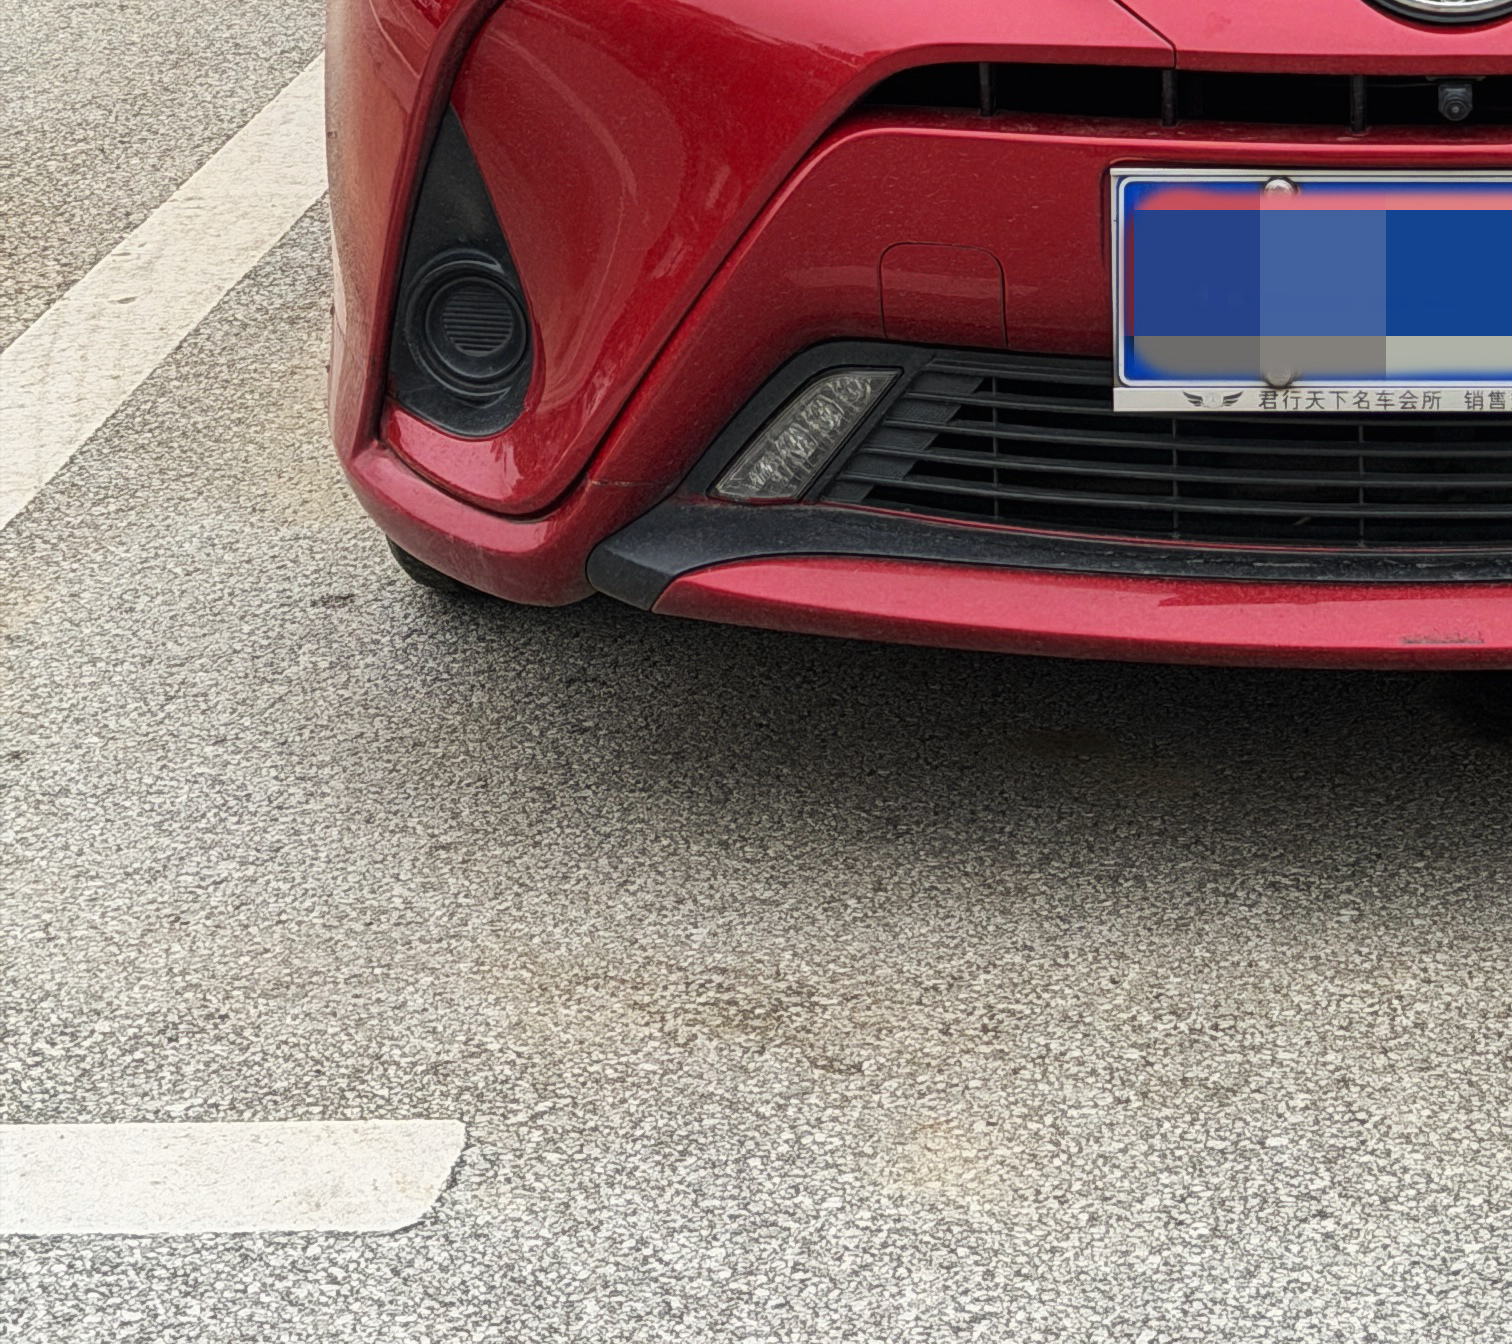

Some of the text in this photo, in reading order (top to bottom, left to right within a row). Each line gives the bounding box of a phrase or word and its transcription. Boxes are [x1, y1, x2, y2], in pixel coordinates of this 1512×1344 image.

[1258, 389, 1442, 410] 君行天下名车会所
